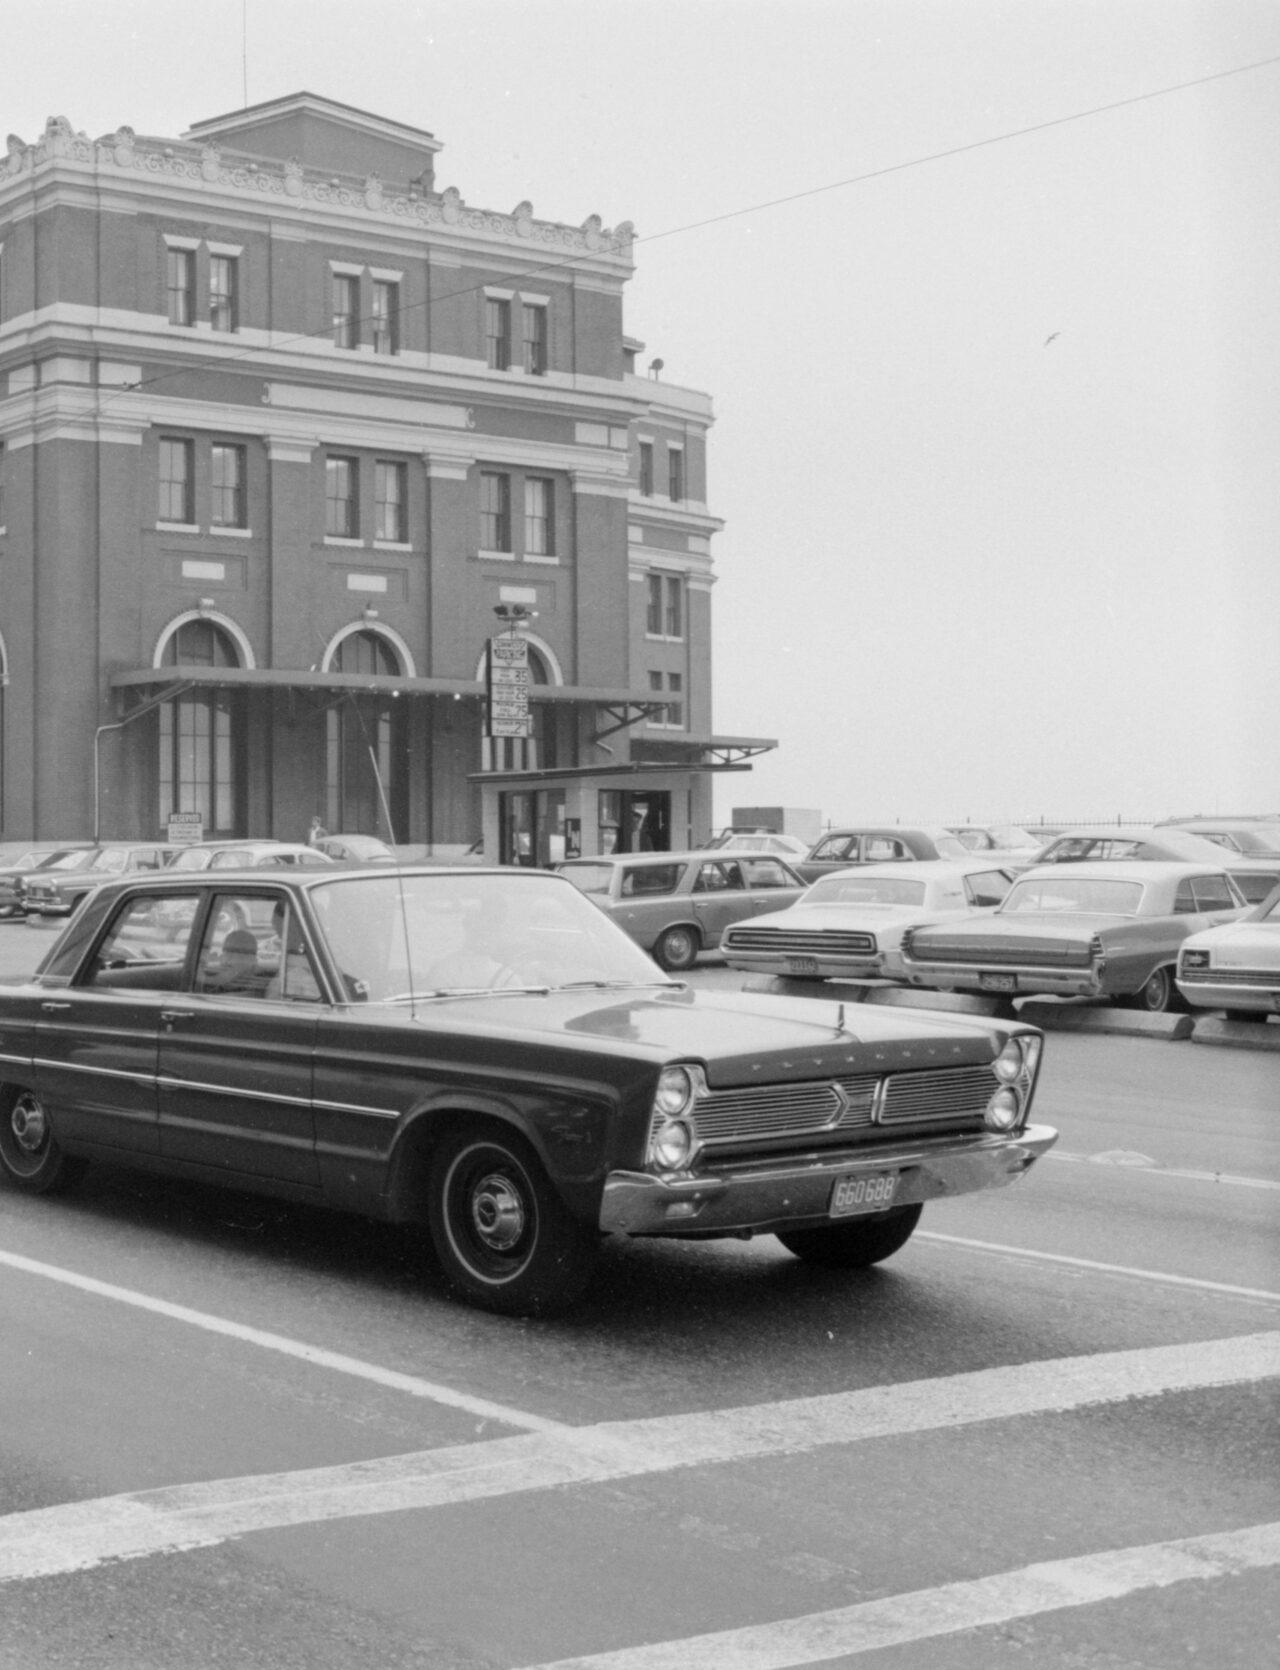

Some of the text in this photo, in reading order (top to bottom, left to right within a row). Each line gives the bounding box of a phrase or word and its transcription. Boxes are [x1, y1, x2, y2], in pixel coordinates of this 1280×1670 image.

[515, 670, 528, 683] 35
[515, 687, 528, 700] 25
[515, 705, 528, 717] 75
